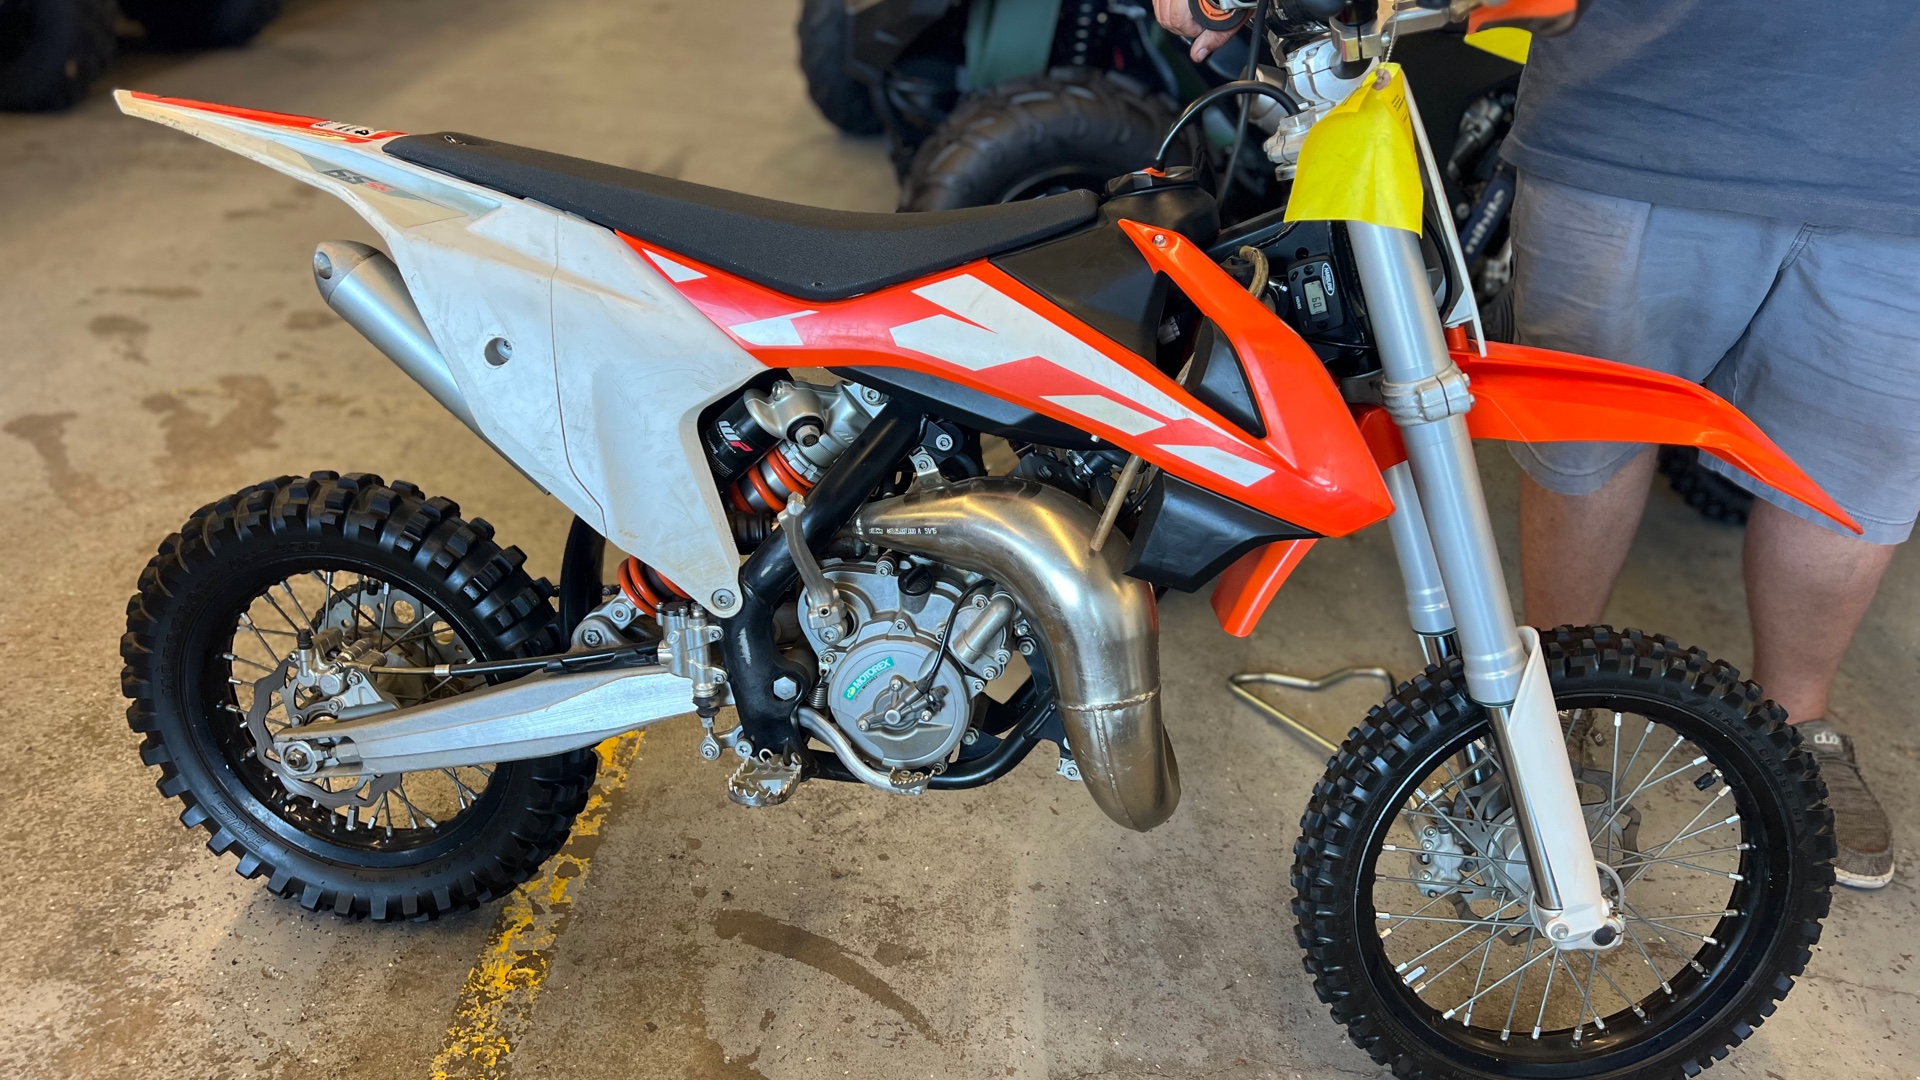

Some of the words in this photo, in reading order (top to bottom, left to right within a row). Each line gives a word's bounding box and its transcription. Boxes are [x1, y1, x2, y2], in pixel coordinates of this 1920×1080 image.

[718, 420, 753, 452] WP
[852, 658, 891, 688] MOTOREX
[1758, 747, 1795, 800] CROSS
